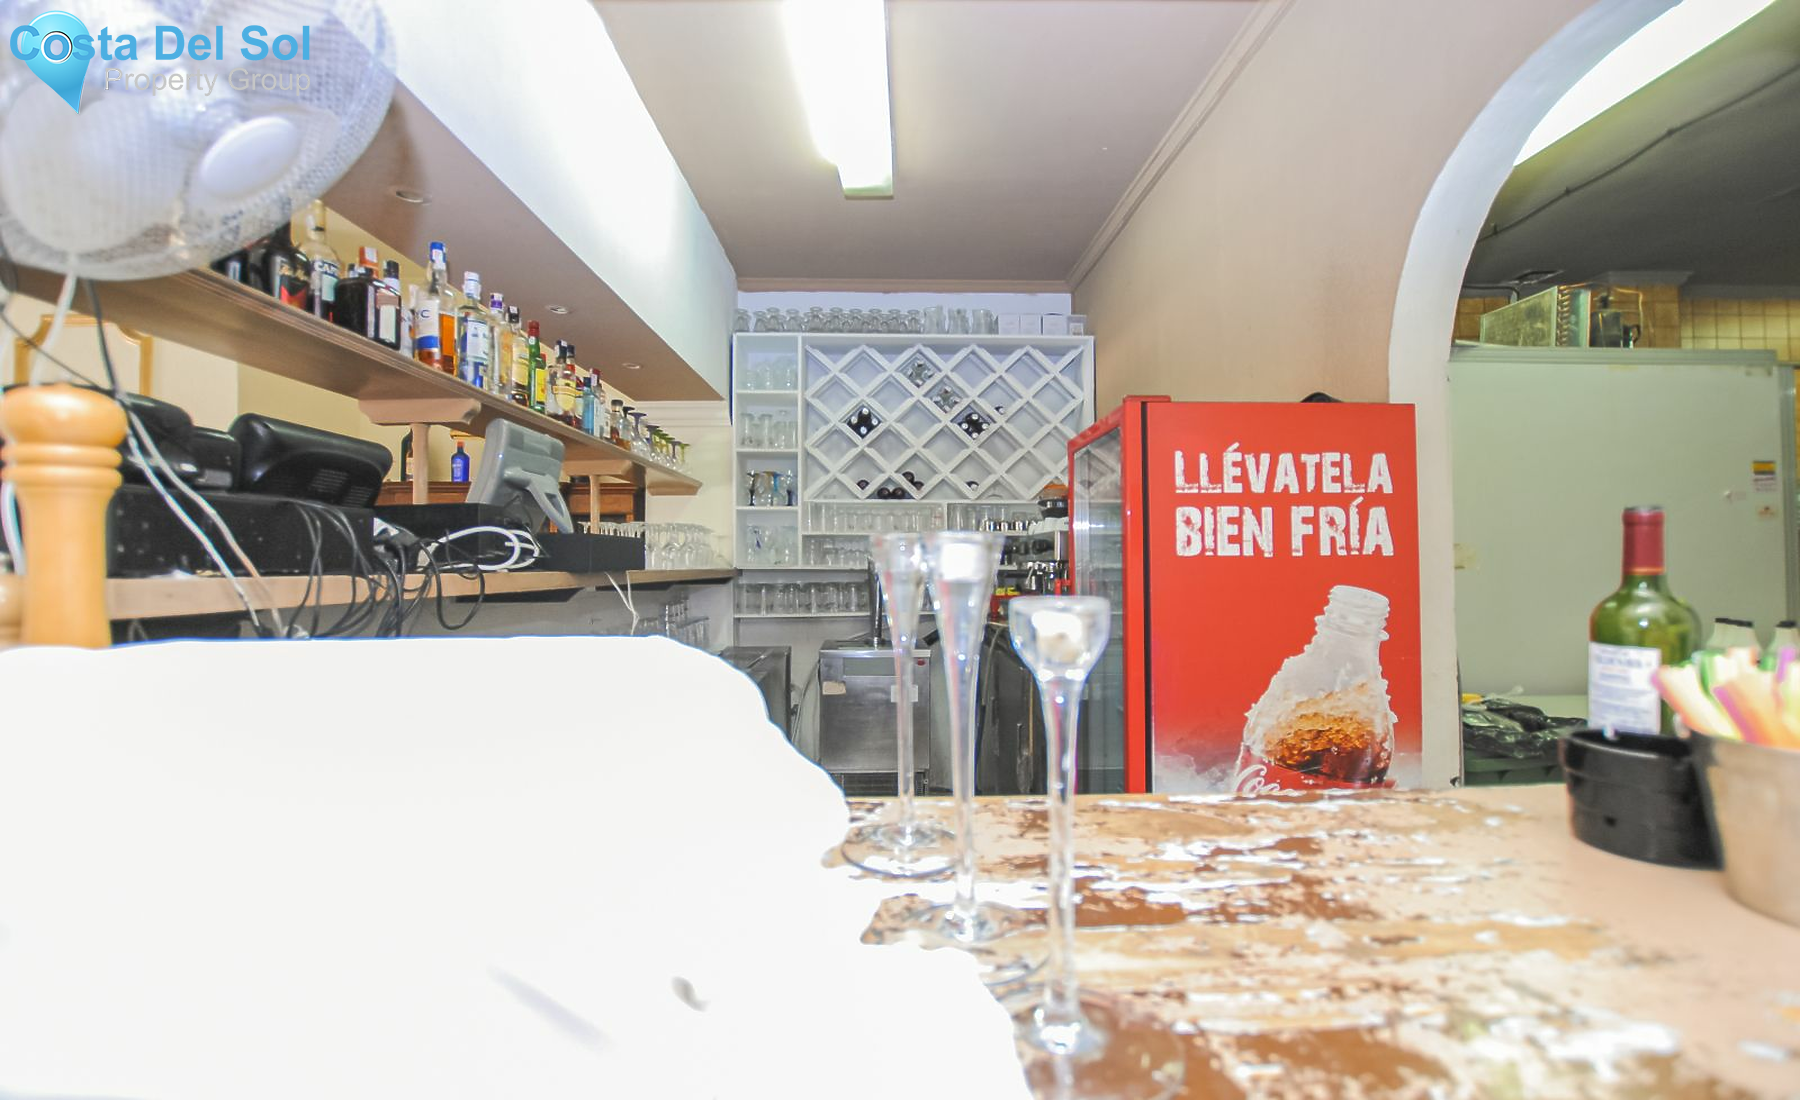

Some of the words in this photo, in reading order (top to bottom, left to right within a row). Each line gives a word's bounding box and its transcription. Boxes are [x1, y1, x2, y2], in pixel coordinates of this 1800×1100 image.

[1174, 442, 1394, 494] LLÉVATELA
[1175, 506, 1273, 557] BIEN
[1290, 496, 1394, 557] FRÍA
